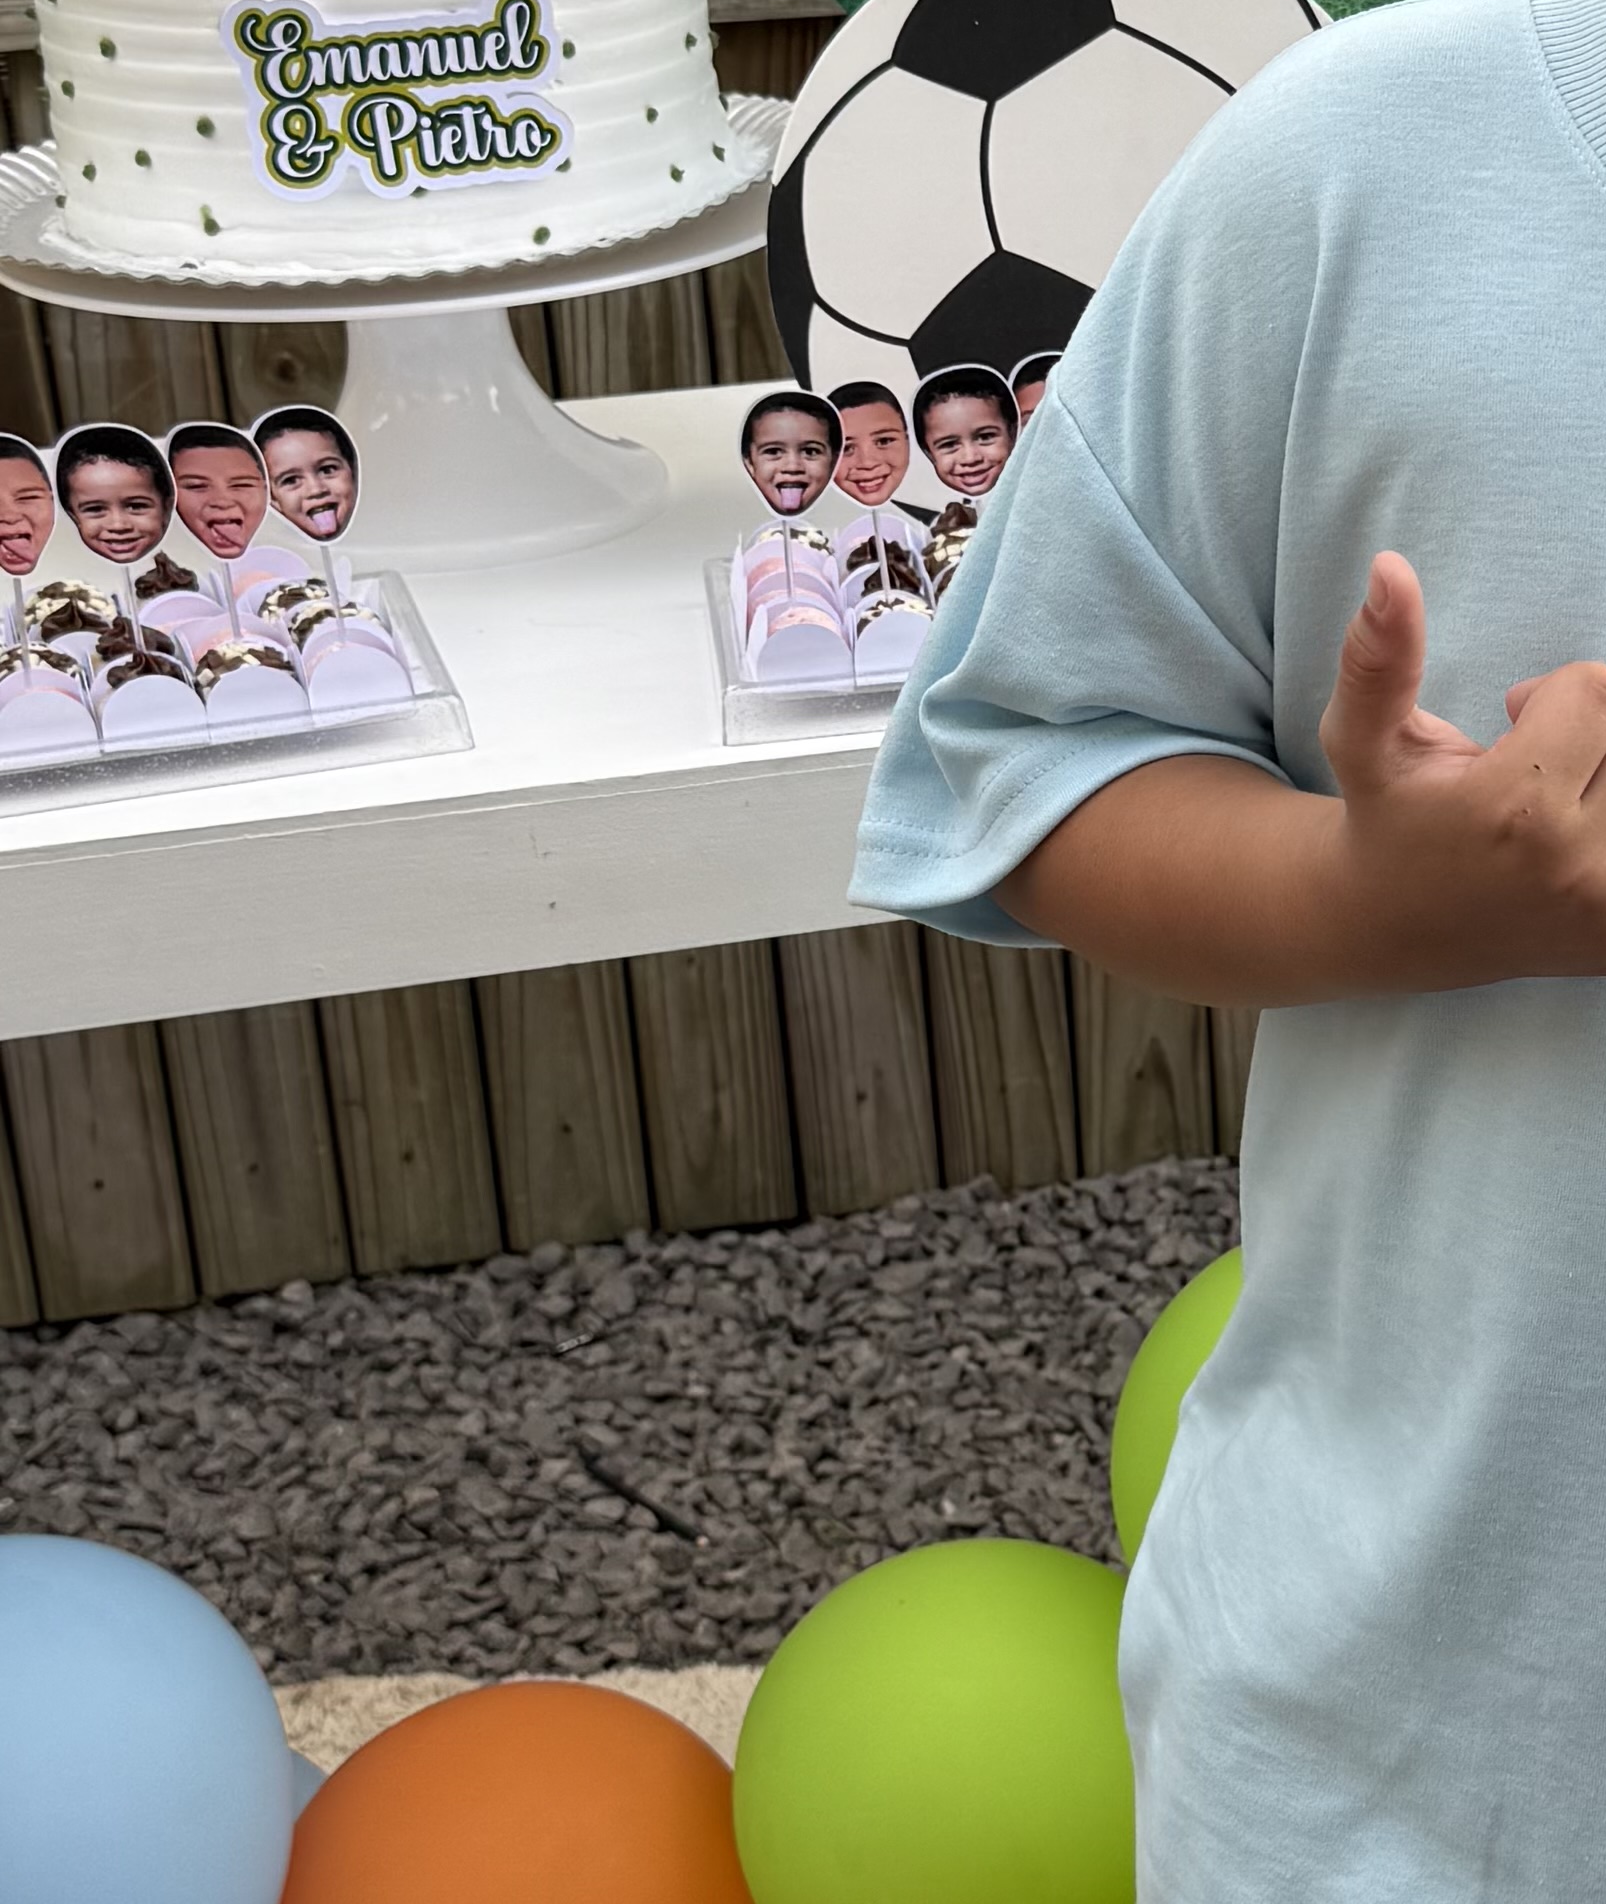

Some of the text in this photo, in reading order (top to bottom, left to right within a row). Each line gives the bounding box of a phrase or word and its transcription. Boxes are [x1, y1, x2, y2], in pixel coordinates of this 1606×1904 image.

[248, 0, 542, 99] Emanuel
[276, 97, 554, 179] & Pietro
